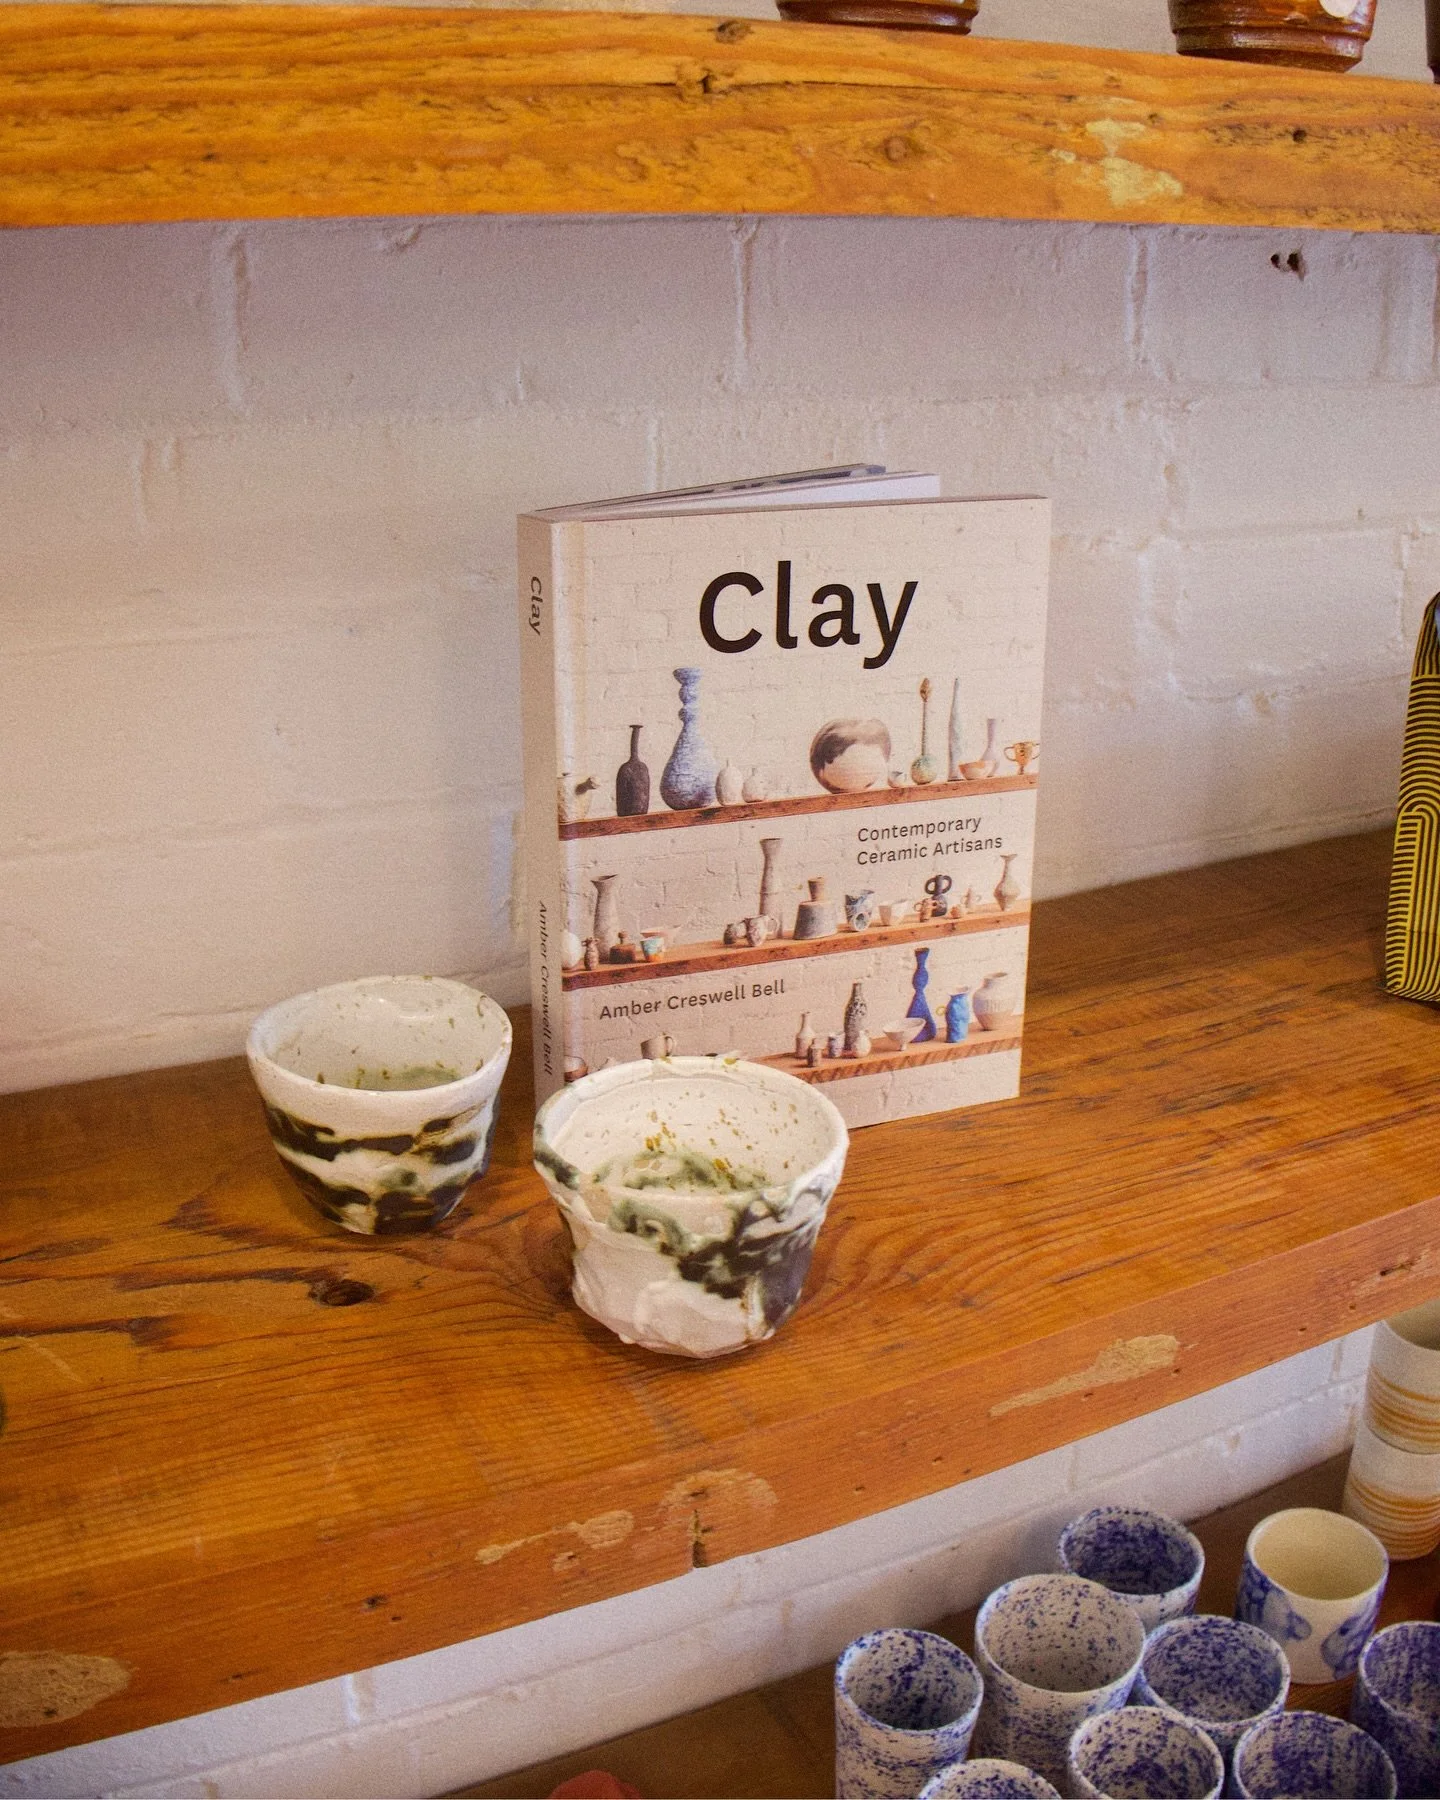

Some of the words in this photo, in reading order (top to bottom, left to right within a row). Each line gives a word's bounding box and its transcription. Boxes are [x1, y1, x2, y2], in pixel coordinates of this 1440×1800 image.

[528, 576, 543, 635] Clay
[698, 560, 919, 669] Clay
[857, 817, 982, 843] Contemporary
[857, 844, 928, 866] Ceramic
[932, 836, 1003, 856] Artisans
[539, 900, 548, 960] Amber
[541, 965, 552, 1039] Creswell
[599, 1000, 661, 1019] Amber
[667, 985, 746, 1010] Creswell
[752, 979, 785, 998] Bell
[543, 1043, 552, 1075] Bell
